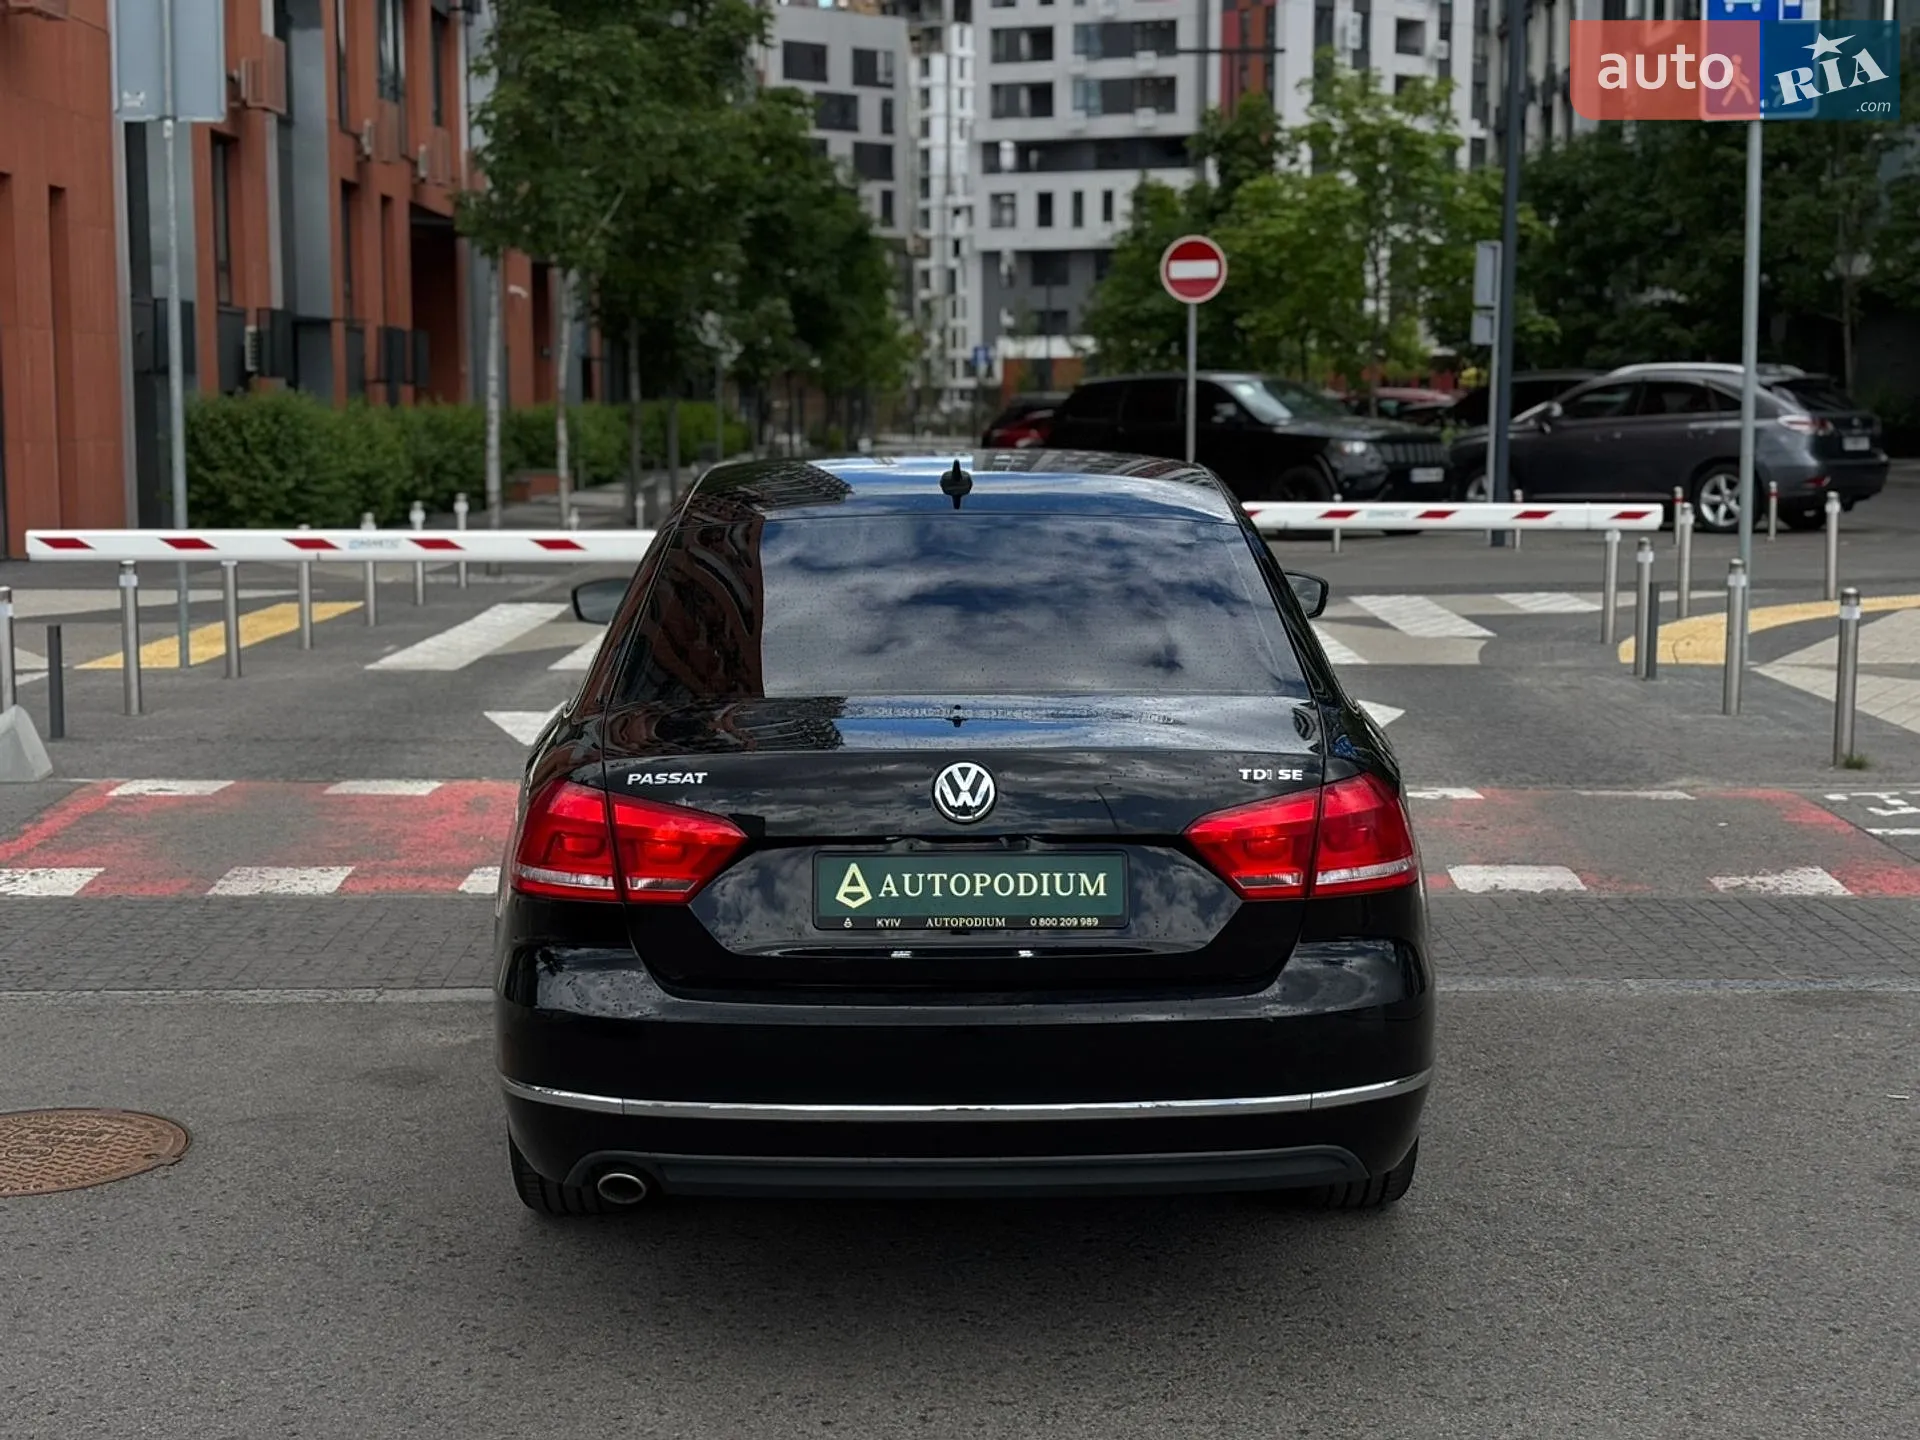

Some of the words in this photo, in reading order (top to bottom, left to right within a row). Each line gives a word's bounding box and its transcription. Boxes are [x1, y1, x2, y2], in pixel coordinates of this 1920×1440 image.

[627, 772, 708, 785] PASSAT
[1238, 768, 1272, 780] TDI
[1278, 769, 1303, 780] SE
[878, 872, 1107, 897] AUTOPODIUM
[876, 918, 901, 928] KYIV
[925, 917, 1006, 928] AUTOPODIUM
[1030, 917, 1037, 927] 0
[1039, 917, 1058, 927] 800
[1059, 917, 1078, 927] 209
[1079, 917, 1099, 927] 989
